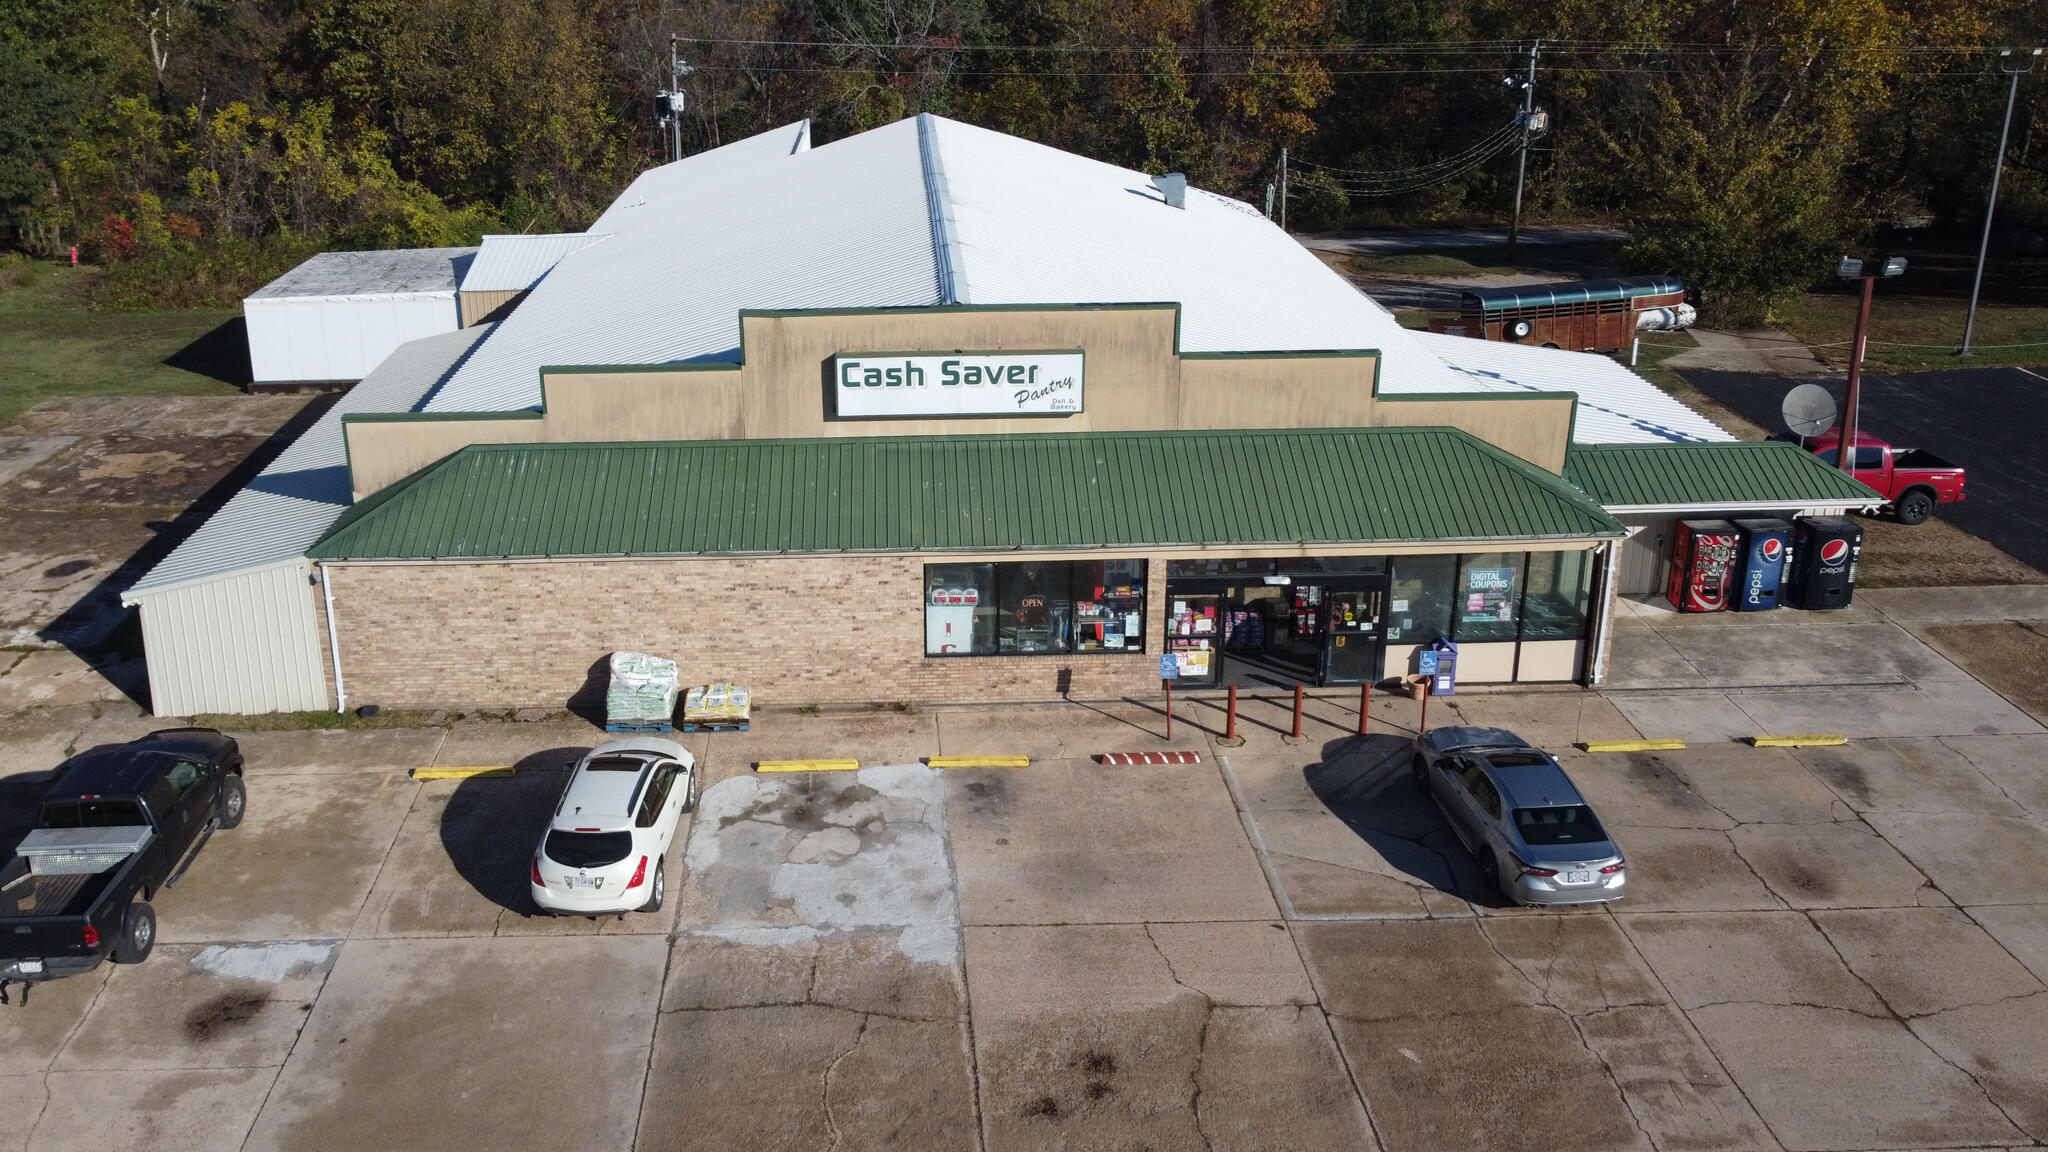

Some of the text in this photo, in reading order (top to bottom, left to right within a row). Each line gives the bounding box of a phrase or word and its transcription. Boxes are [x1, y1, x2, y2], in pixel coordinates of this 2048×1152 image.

[842, 360, 1038, 387] Cash Saver
[1014, 376, 1073, 408] Pantry
[1820, 565, 1845, 575] pepsi
[1470, 572, 1500, 580] DIGITAL
[1470, 580, 1508, 589] COUPONS
[1748, 570, 1764, 604] pepsi
[1022, 599, 1044, 607] OPEN
